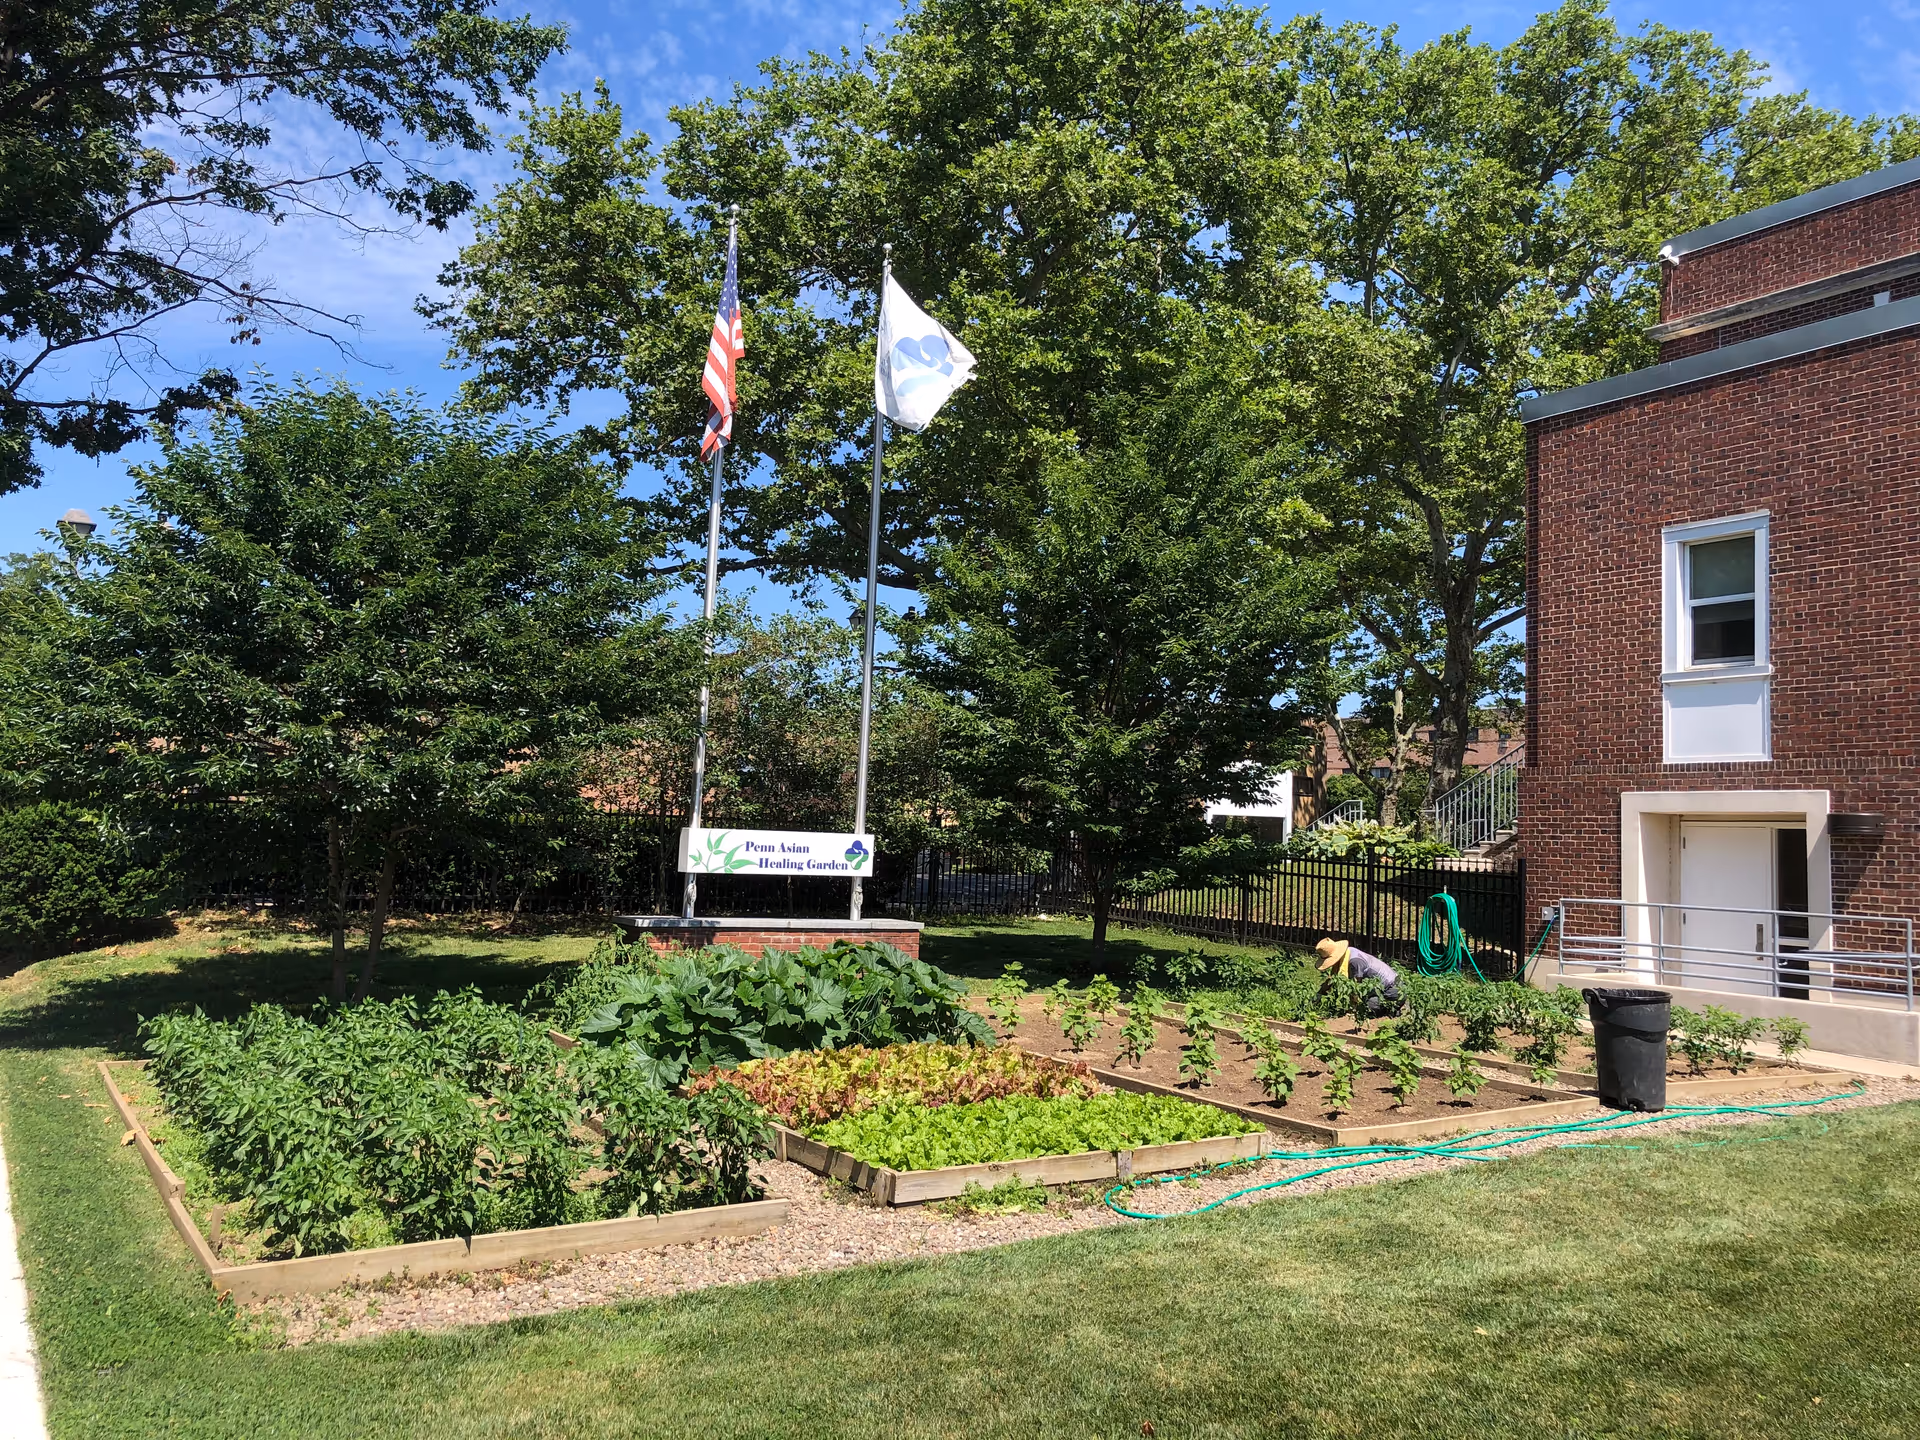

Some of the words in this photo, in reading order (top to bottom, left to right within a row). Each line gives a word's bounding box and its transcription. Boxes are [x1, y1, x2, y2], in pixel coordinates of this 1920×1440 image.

[745, 841, 775, 853] Penn
[778, 842, 810, 854] Asian
[758, 857, 804, 871] Healing
[806, 858, 848, 871] Garden
